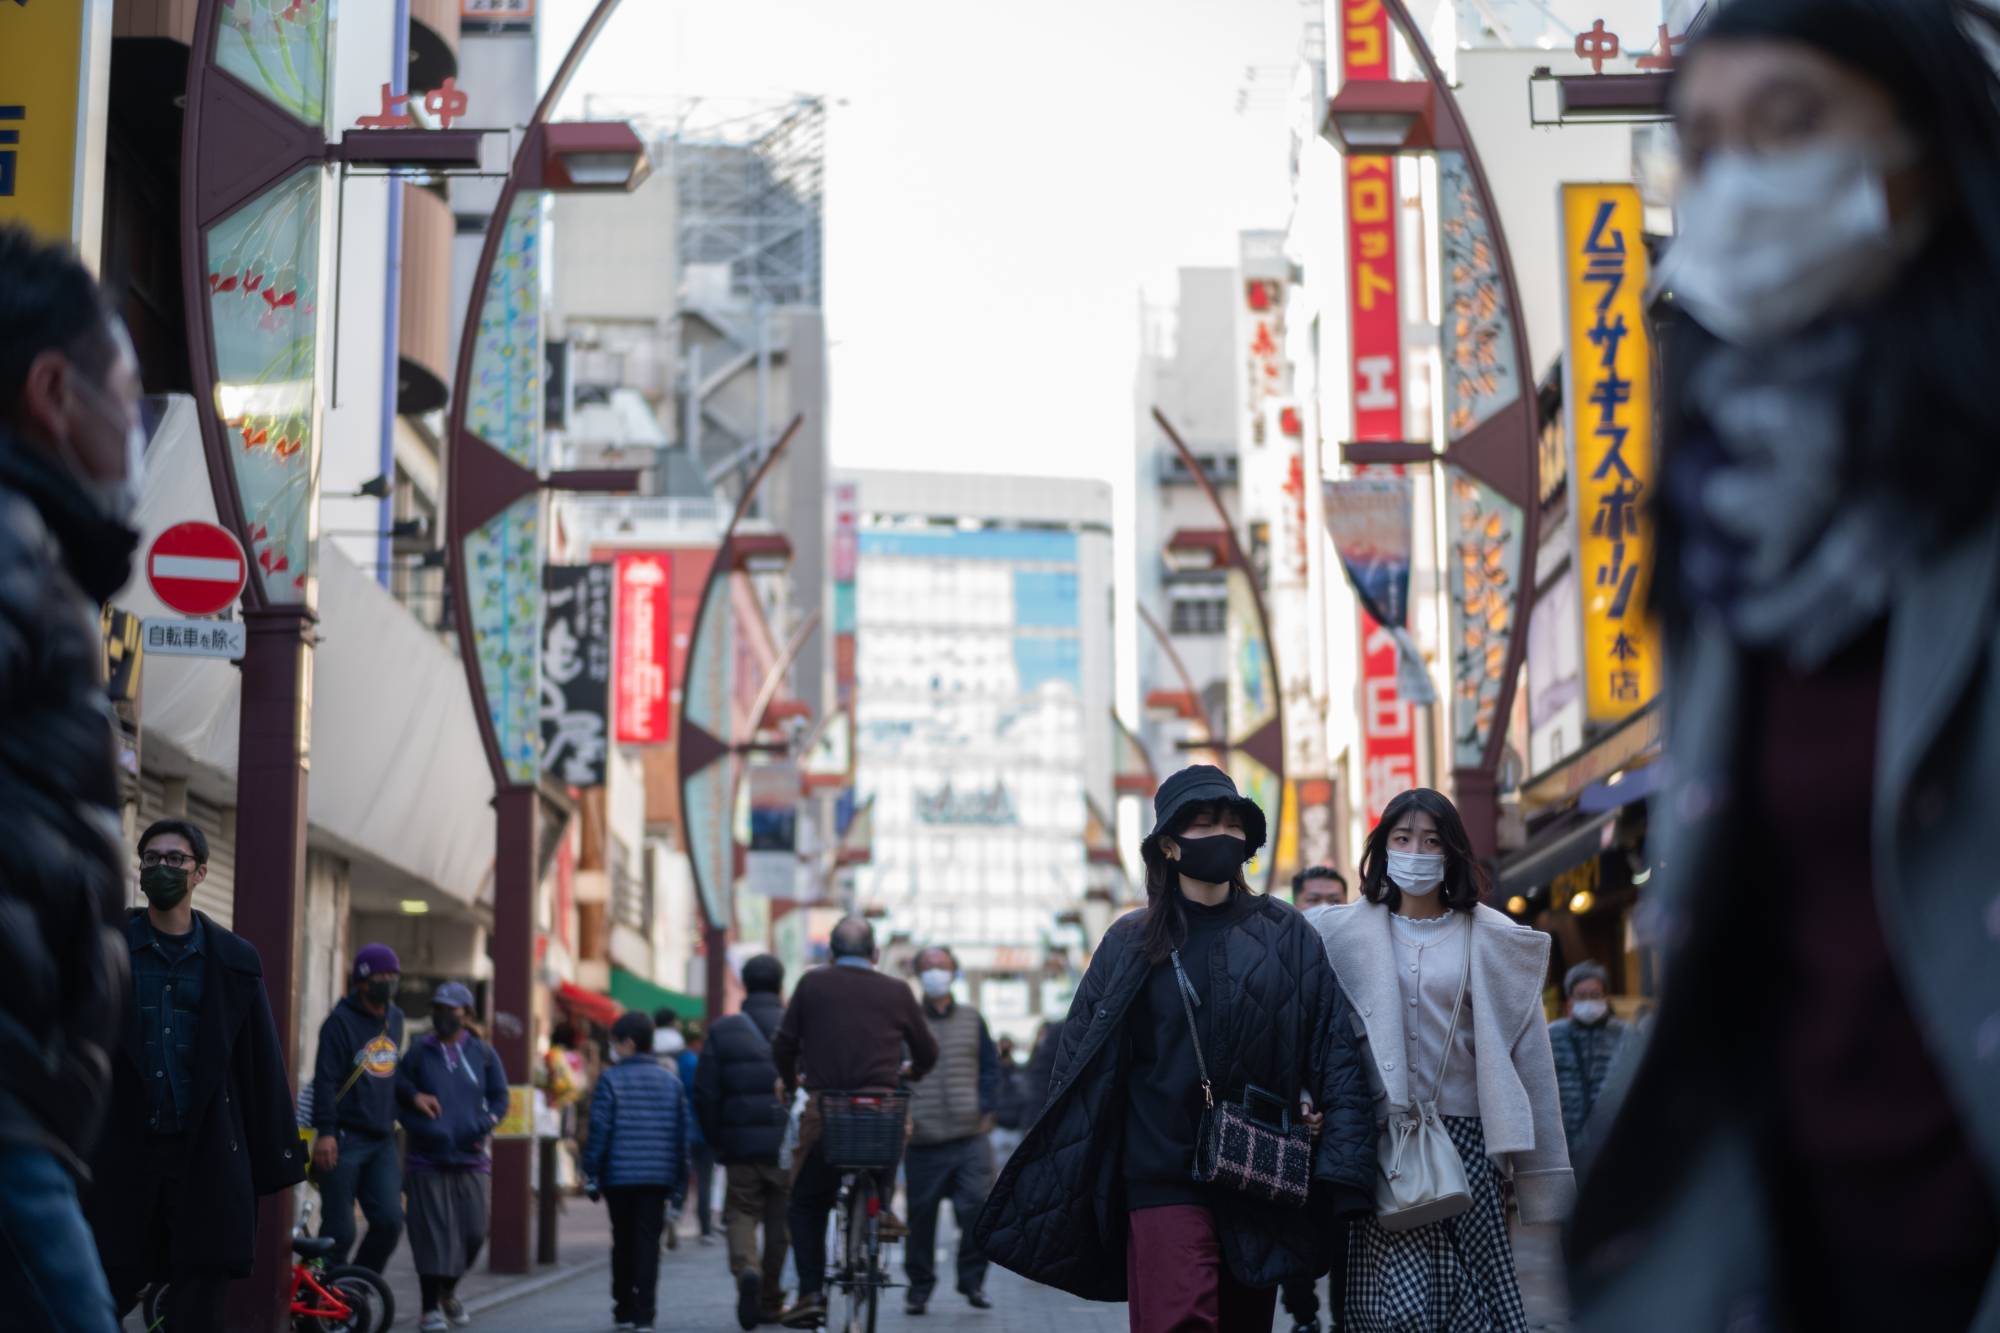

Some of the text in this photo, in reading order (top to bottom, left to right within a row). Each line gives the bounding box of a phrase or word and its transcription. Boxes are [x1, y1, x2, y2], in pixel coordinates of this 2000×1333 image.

[355, 76, 468, 129] 上中
[1582, 201, 1644, 702] ムラサキスポーツ 本店
[148, 624, 240, 651] 自転車を除く
